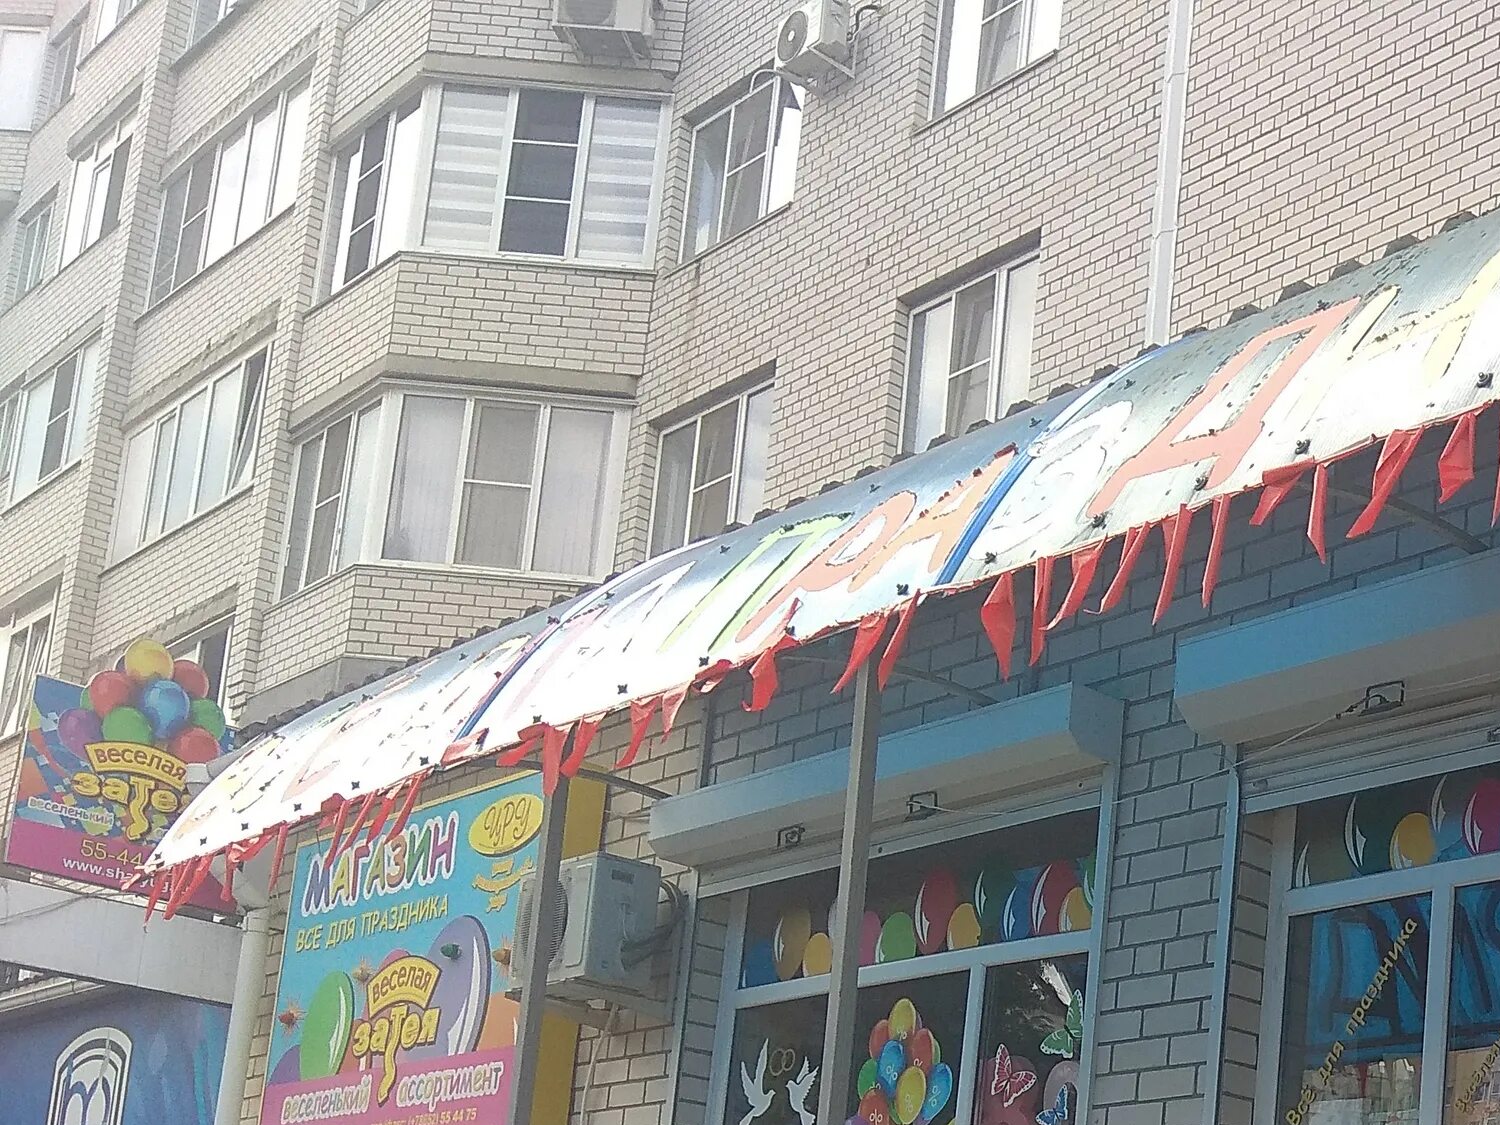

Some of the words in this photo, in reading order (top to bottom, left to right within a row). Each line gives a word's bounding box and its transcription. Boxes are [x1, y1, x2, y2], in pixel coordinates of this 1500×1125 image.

[96, 747, 187, 781] веселая
[28, 796, 115, 829] веселенький
[72, 771, 190, 841] зате
[484, 798, 531, 846] ЦРУ
[302, 811, 459, 917] МАГАЗИН
[296, 925, 321, 953] ВСЕ
[328, 915, 356, 949] ДЛЯ
[361, 893, 450, 940] ПРАЗДНИКА
[1318, 1040, 1344, 1087] для
[1346, 918, 1417, 1036] праздника
[281, 1074, 372, 1125] веселенький
[397, 1062, 504, 1112] ассортимент
